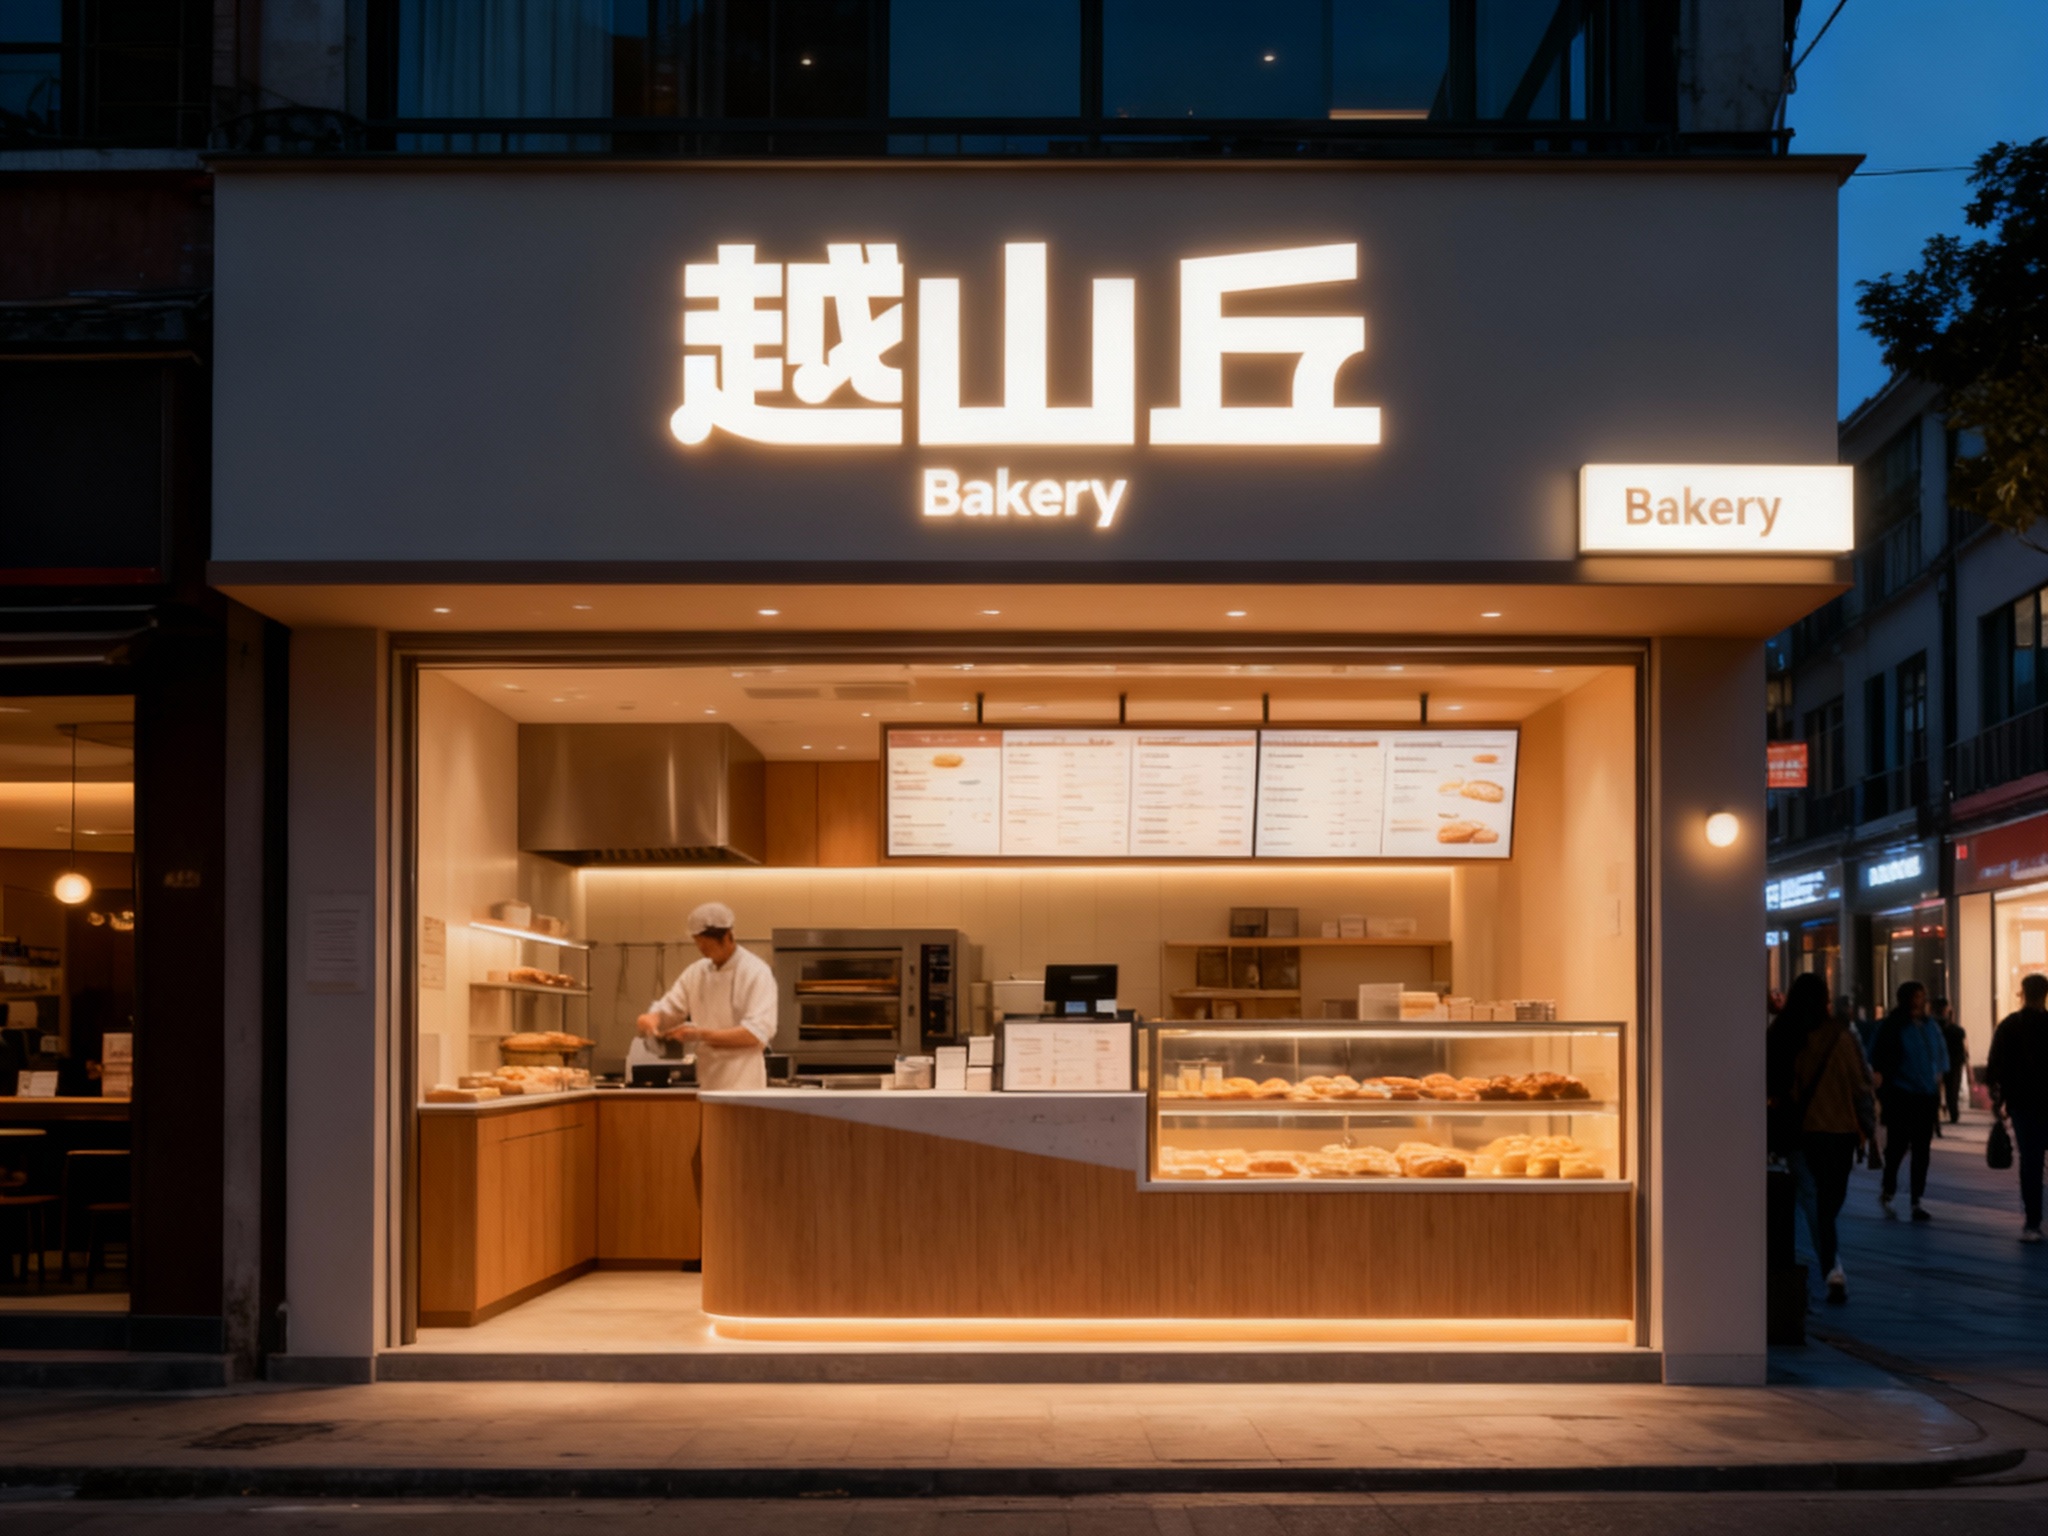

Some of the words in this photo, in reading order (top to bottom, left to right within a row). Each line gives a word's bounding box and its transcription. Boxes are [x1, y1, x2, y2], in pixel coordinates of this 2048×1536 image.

[670, 242, 1381, 445] 越山丘
[922, 468, 1127, 528] Bakery
[1625, 486, 1782, 537] Bakery
